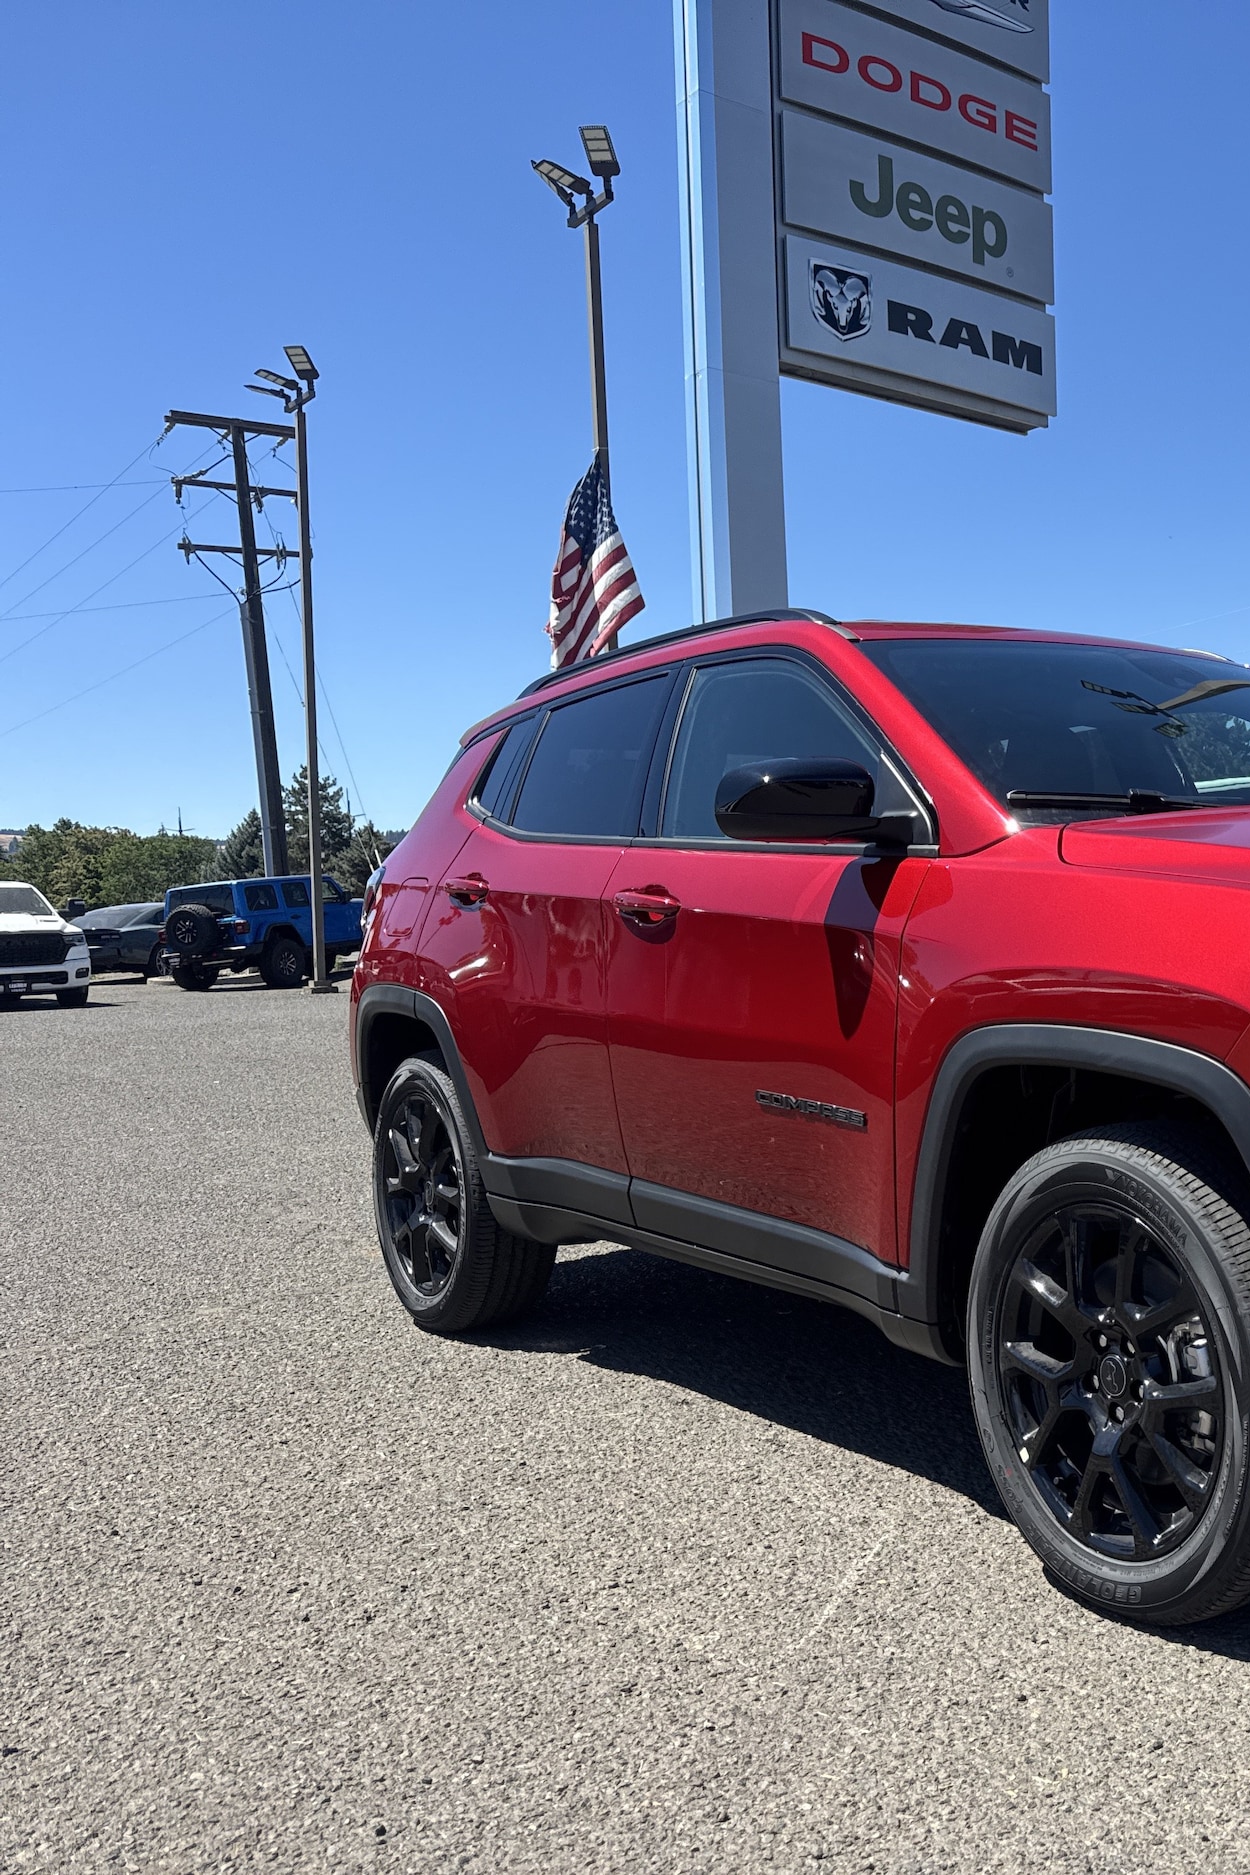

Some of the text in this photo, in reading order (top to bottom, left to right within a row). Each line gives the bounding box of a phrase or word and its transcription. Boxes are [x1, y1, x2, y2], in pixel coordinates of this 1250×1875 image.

[801, 31, 1038, 151] DODGE
[849, 154, 1008, 266] Jeep
[887, 299, 1043, 376] RAM
